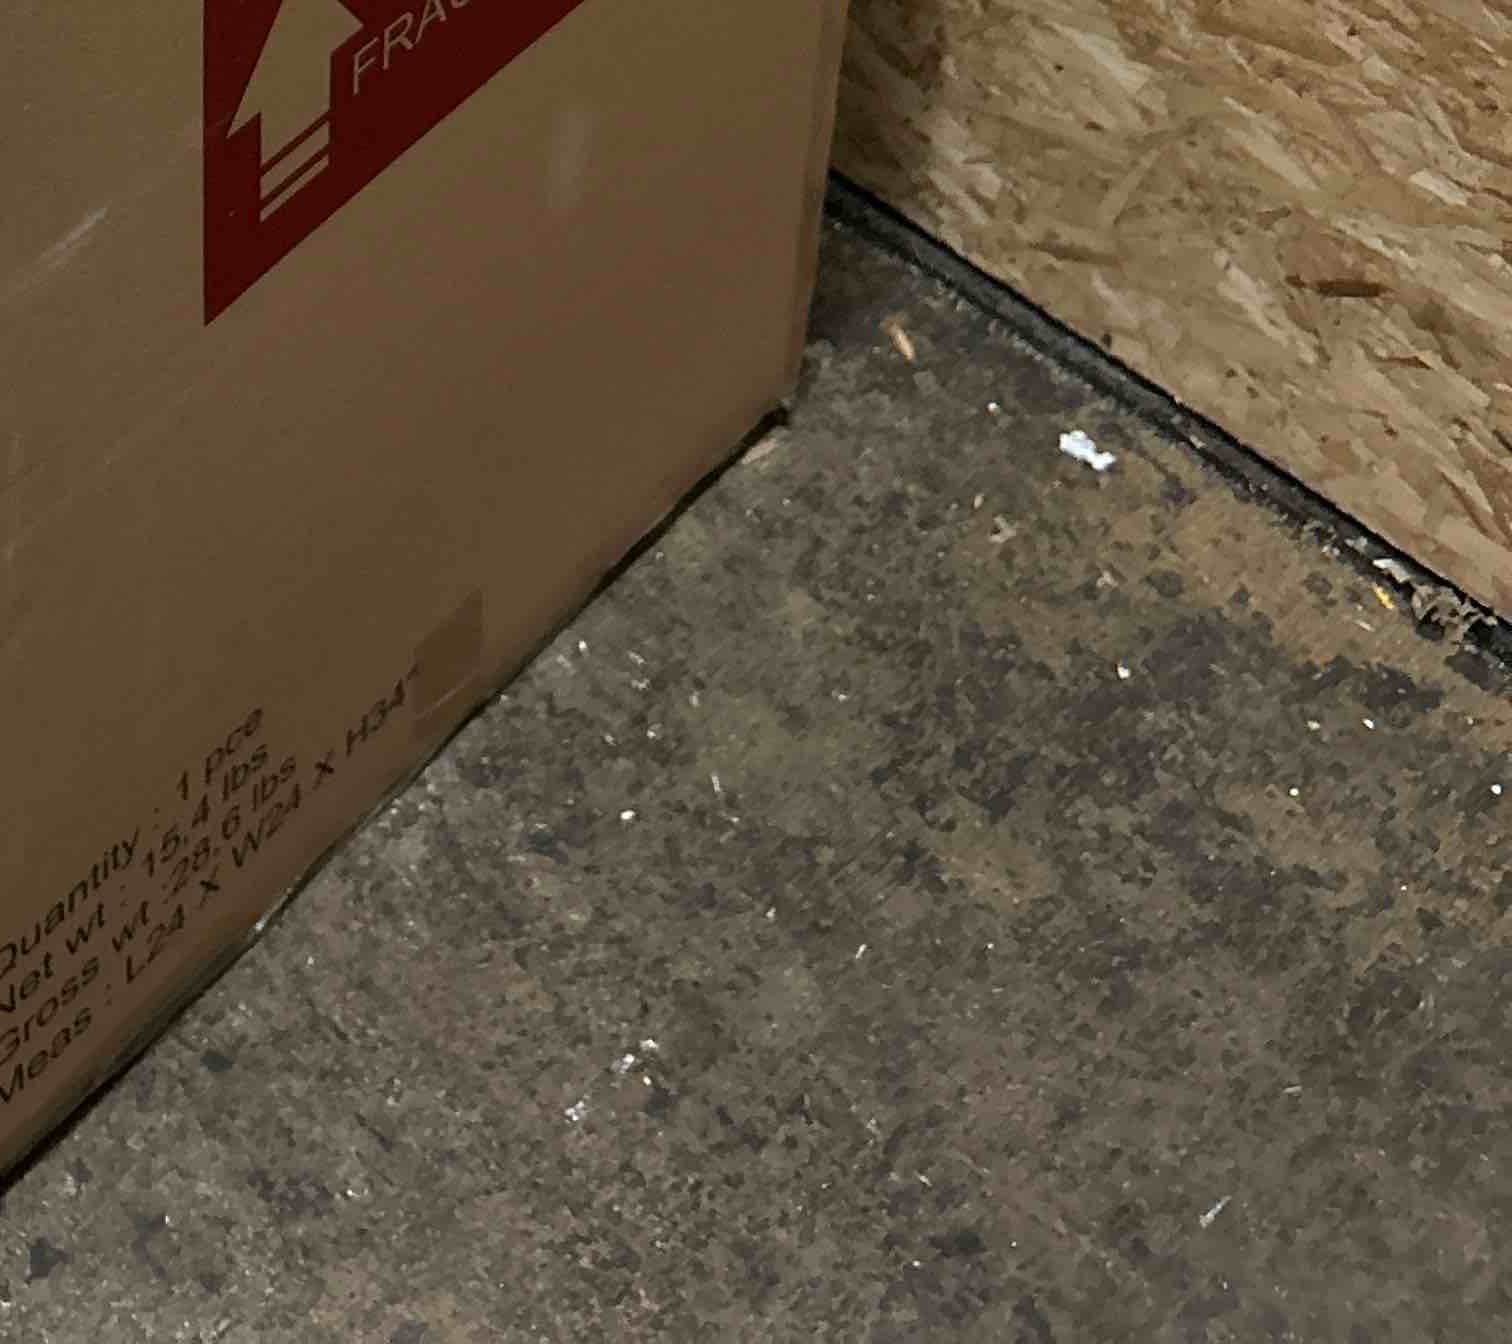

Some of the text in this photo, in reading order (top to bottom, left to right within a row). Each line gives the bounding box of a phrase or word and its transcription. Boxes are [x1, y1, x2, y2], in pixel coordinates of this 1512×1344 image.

[204, 707, 264, 784] pce
[65, 902, 105, 955] wt
[221, 743, 268, 801] lbs
[112, 900, 149, 953] wt
[252, 756, 296, 811] lbs
[126, 904, 185, 984] L24
[231, 783, 301, 868] W24
